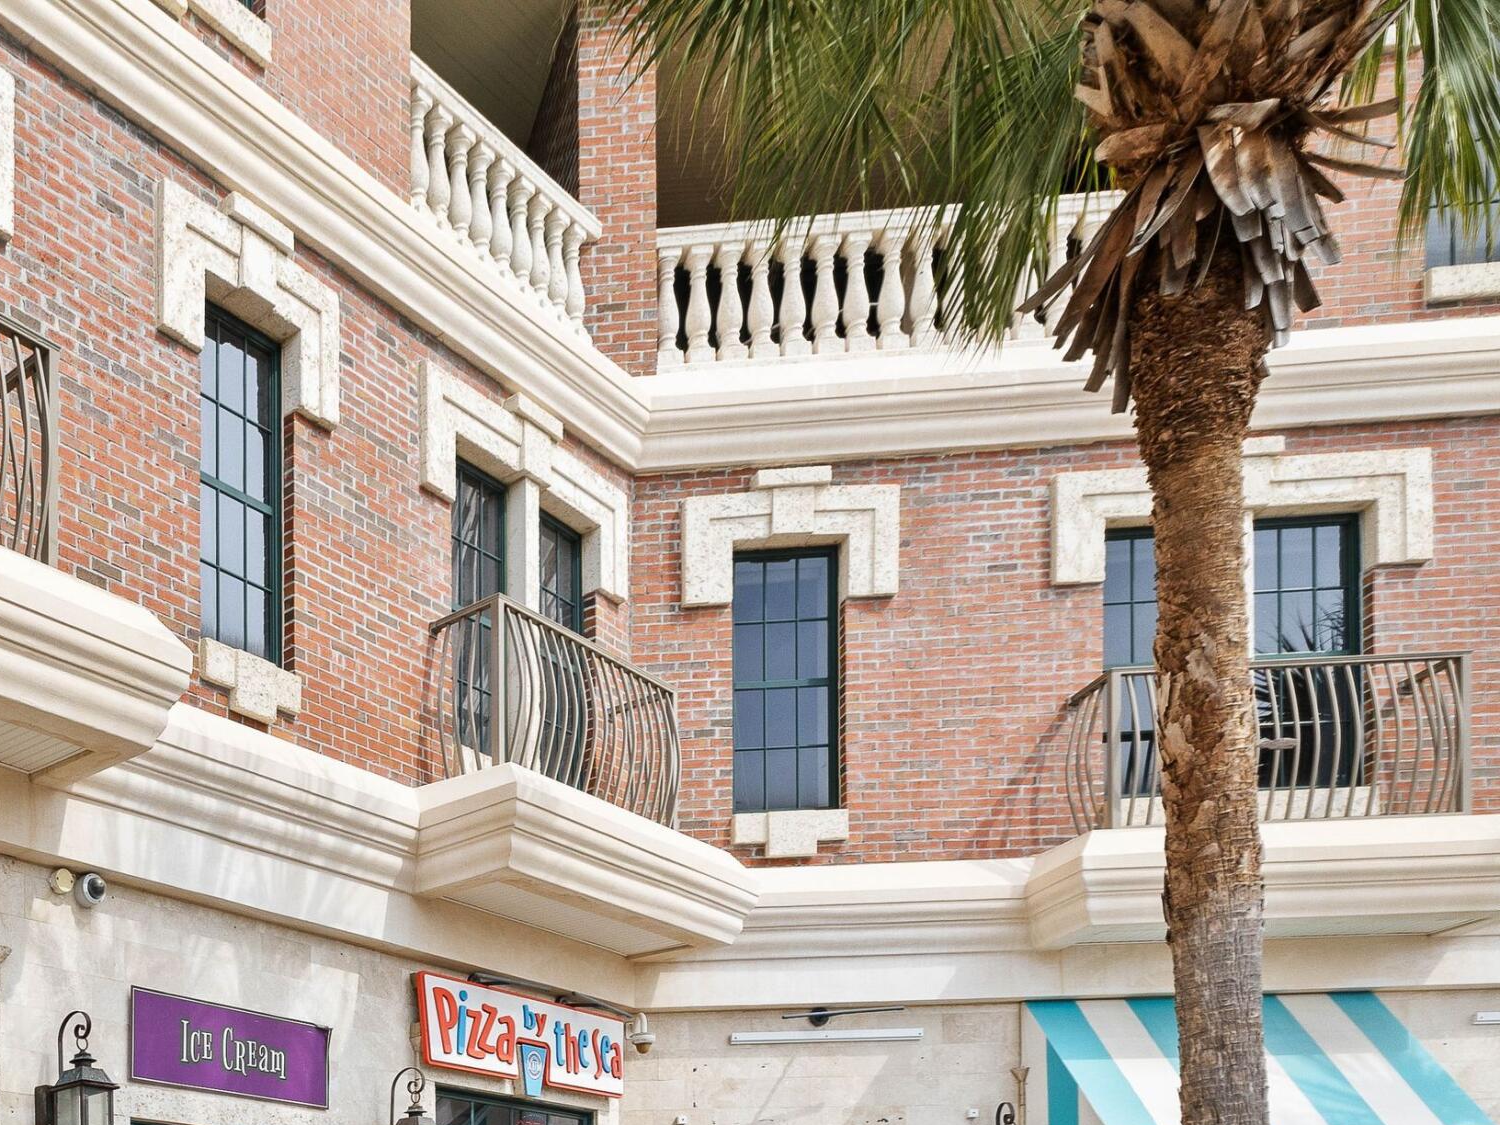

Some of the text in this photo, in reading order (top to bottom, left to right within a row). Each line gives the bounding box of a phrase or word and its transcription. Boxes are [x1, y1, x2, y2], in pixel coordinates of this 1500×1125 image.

[432, 986, 516, 1065] Pizza
[522, 1004, 547, 1037] by
[553, 1020, 590, 1075] the
[591, 1028, 625, 1081] Sea
